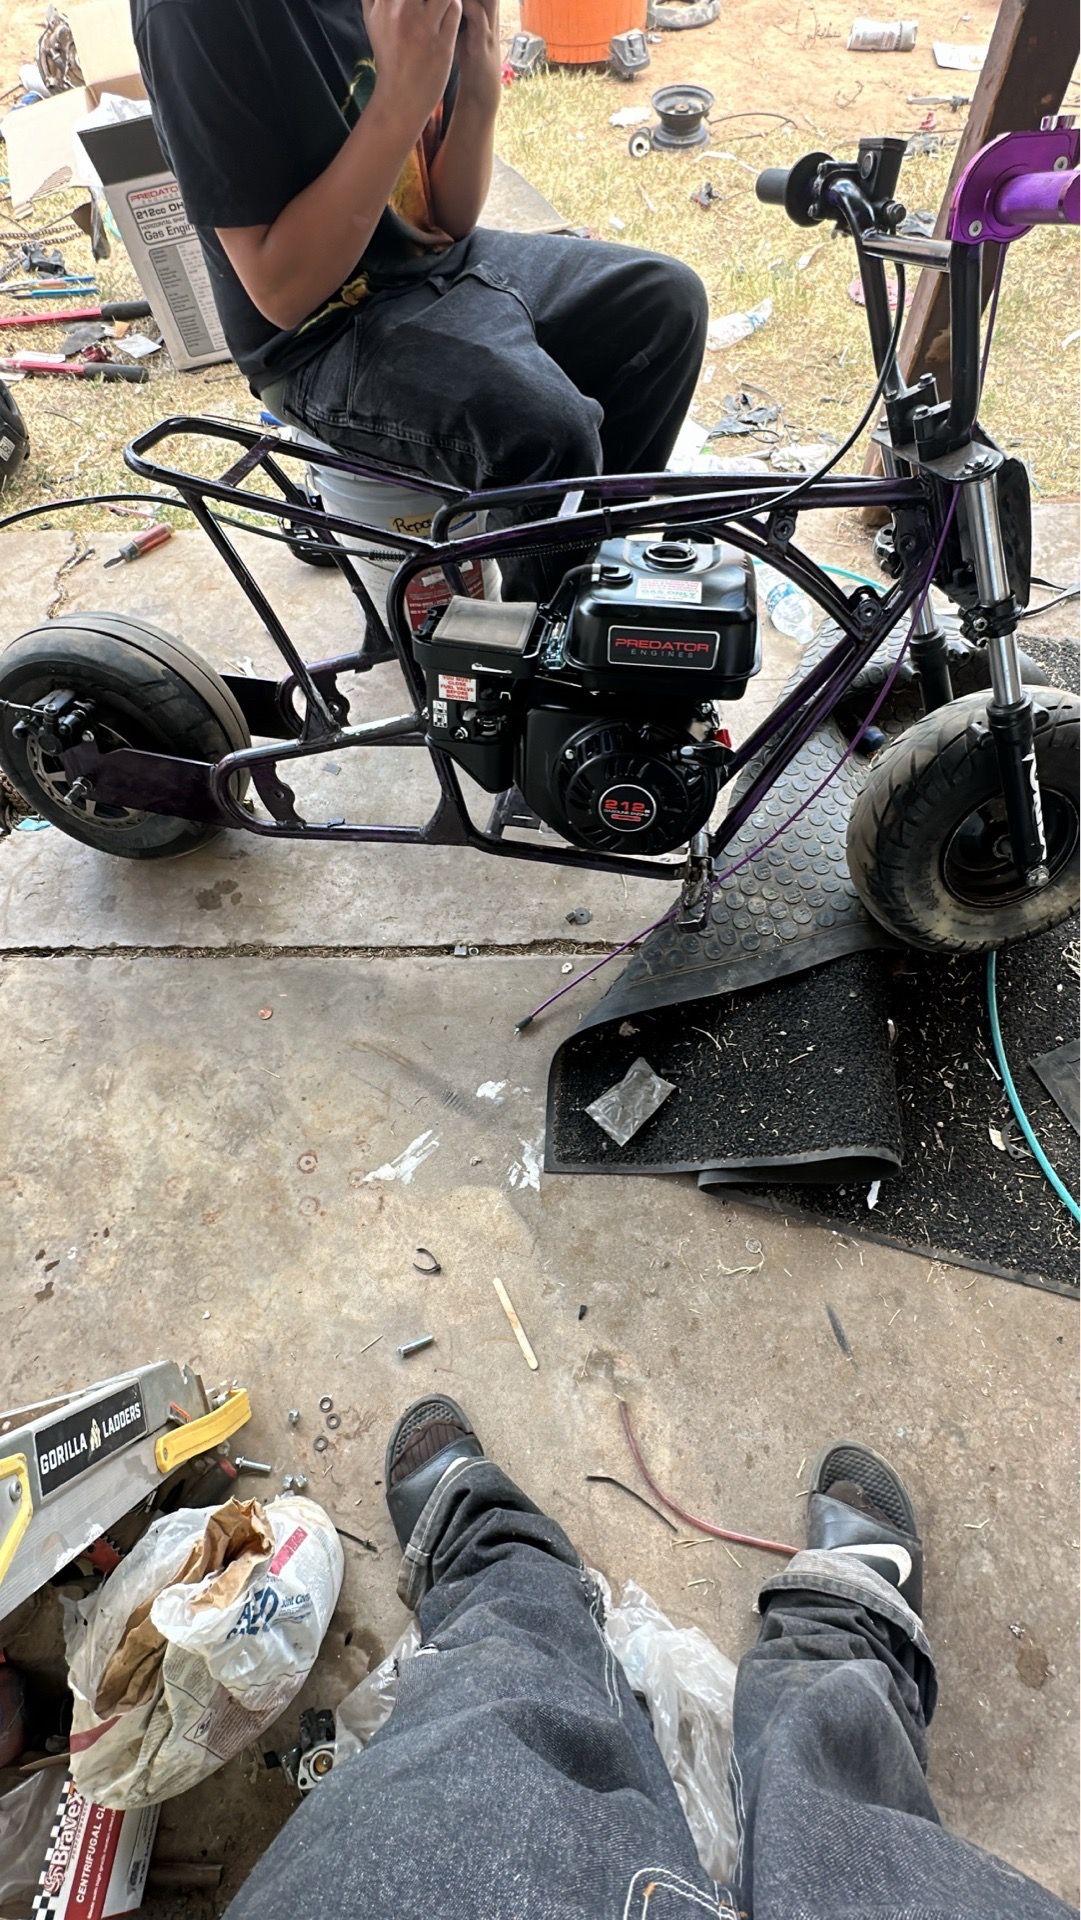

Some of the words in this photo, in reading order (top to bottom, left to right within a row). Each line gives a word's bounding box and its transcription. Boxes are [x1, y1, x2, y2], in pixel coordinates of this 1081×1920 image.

[130, 185, 178, 202] PREDATO
[136, 206, 166, 220] 212cc
[168, 201, 184, 212] OH
[144, 229, 164, 241] Gas
[166, 222, 194, 236] Engin
[615, 638, 709, 652] PREDATOR
[631, 649, 694, 658] ENGINES
[605, 800, 645, 811] 212
[40, 1432, 87, 1475] GORILLA
[102, 1402, 141, 1438] LADDERS
[56, 1792, 84, 1866] Bravex
[76, 1823, 102, 1903] CENTRIFUGAL
